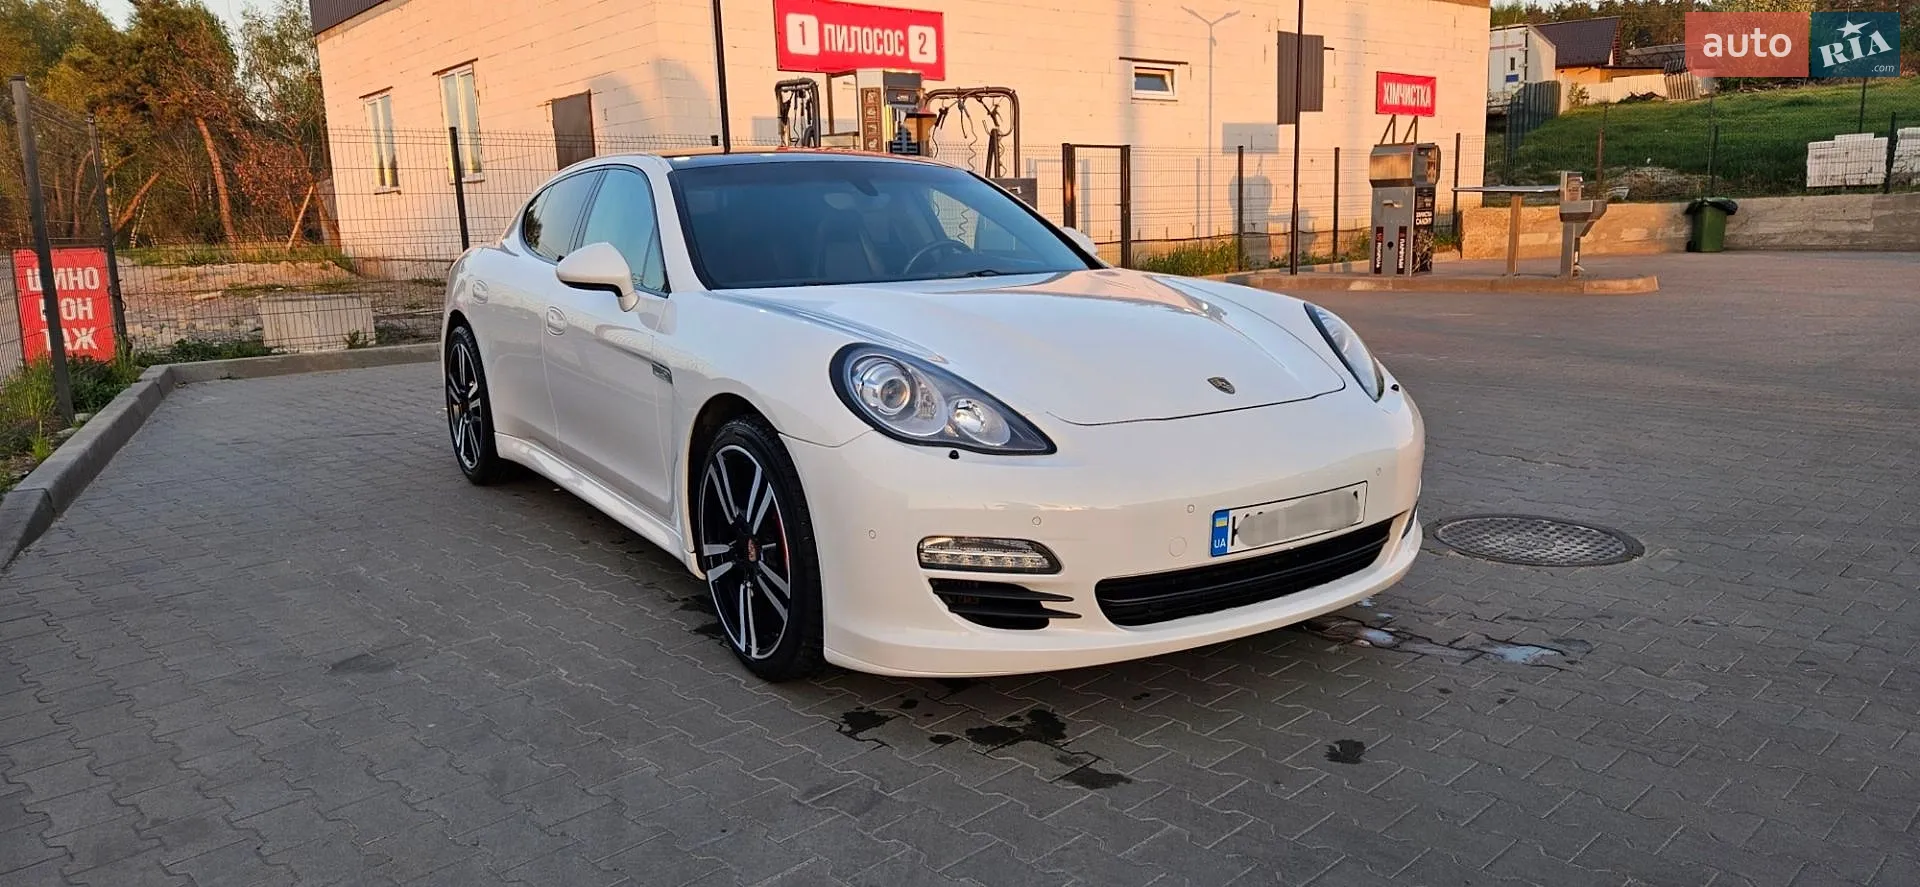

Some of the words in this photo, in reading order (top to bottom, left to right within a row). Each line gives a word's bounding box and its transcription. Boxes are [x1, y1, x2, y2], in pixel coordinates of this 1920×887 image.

[799, 21, 806, 46] 1
[823, 23, 905, 57] ПИЛОСОС
[918, 32, 927, 55] 2
[1383, 82, 1432, 107] ХІМЧИСТКА
[1214, 537, 1226, 549] UA
